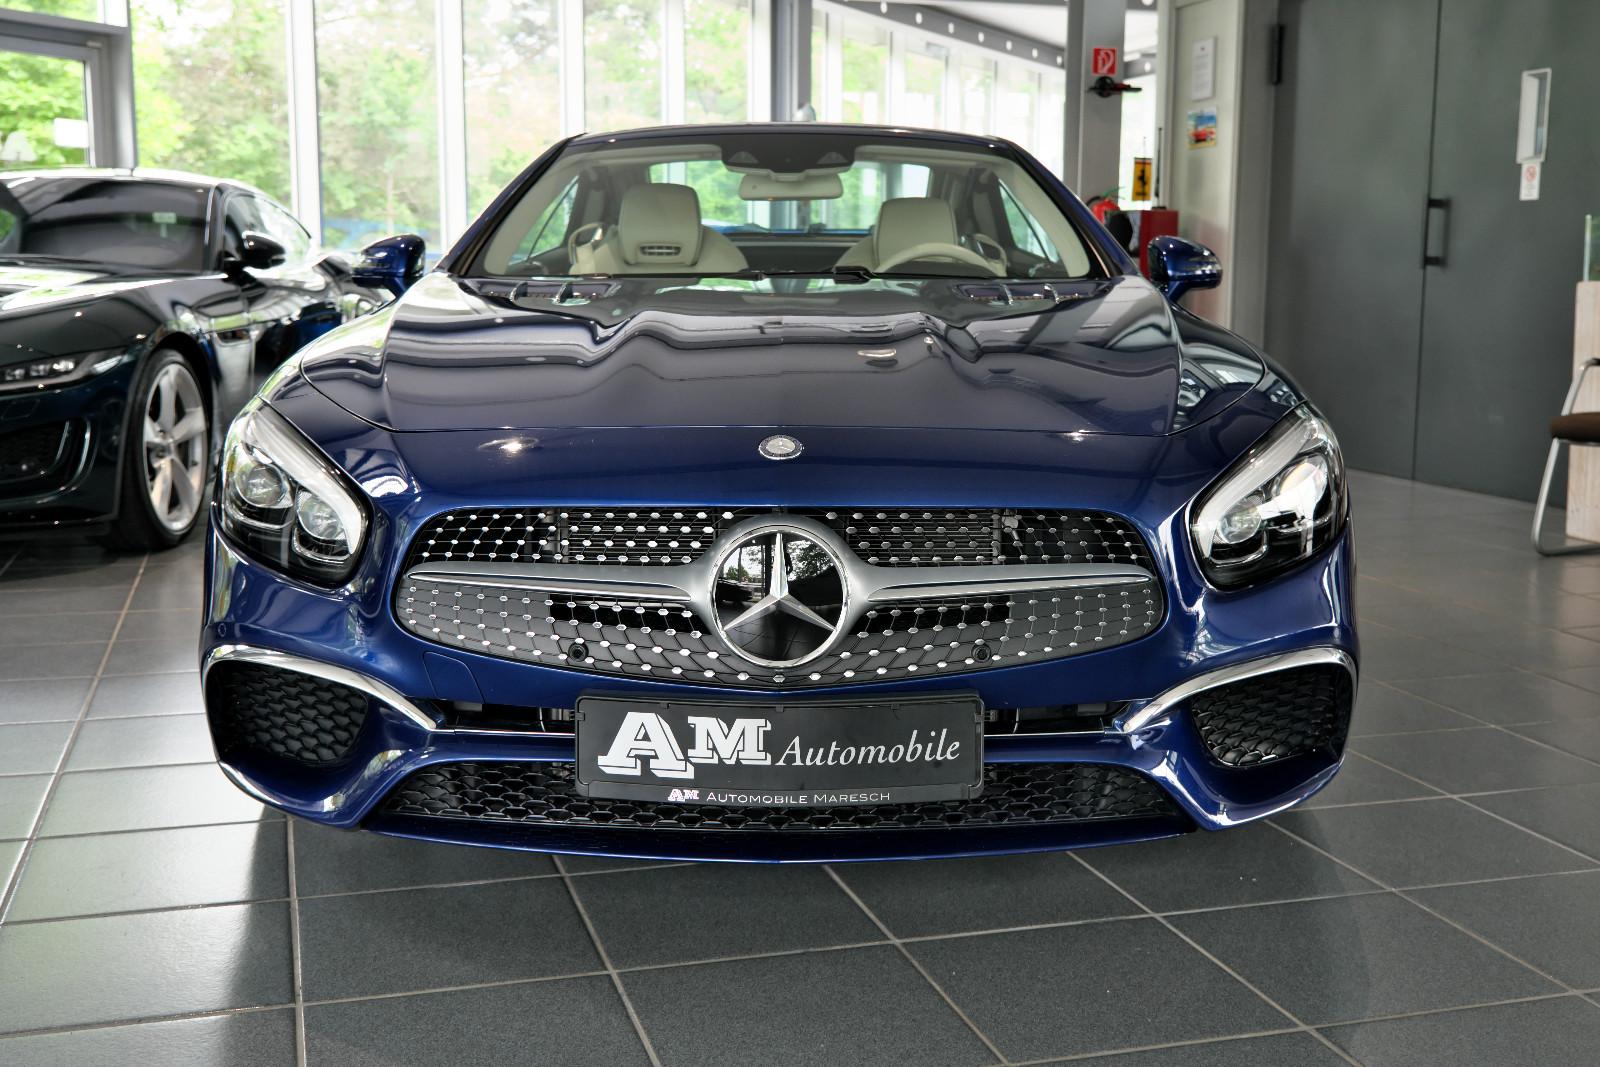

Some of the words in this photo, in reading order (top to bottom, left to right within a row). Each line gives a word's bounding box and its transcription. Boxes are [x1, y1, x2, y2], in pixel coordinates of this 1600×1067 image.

[597, 711, 772, 779] AM
[775, 728, 960, 766] Automobile
[668, 788, 700, 802] AM
[706, 792, 808, 805] AUTOMOBILE
[814, 792, 891, 804] MARESCH
